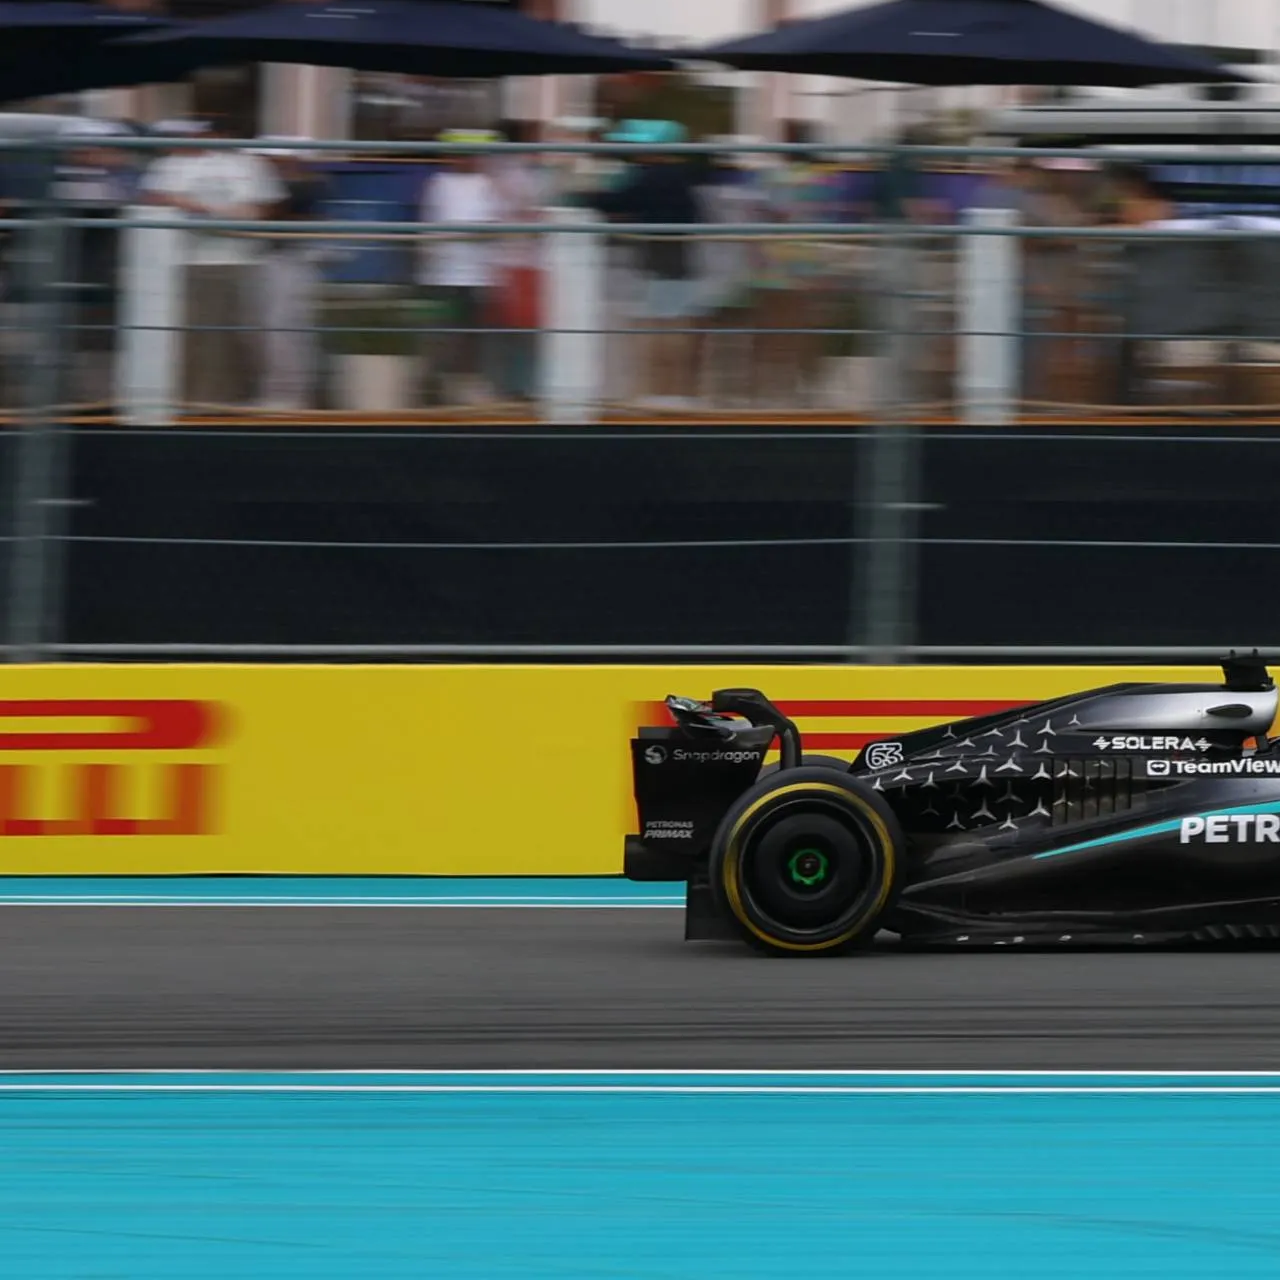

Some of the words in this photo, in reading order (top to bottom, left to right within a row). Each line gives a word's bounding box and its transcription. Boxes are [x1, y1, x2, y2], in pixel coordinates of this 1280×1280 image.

[1111, 736, 1196, 751] SOLERA
[673, 749, 760, 763] Snapdragon
[866, 742, 904, 769] 63
